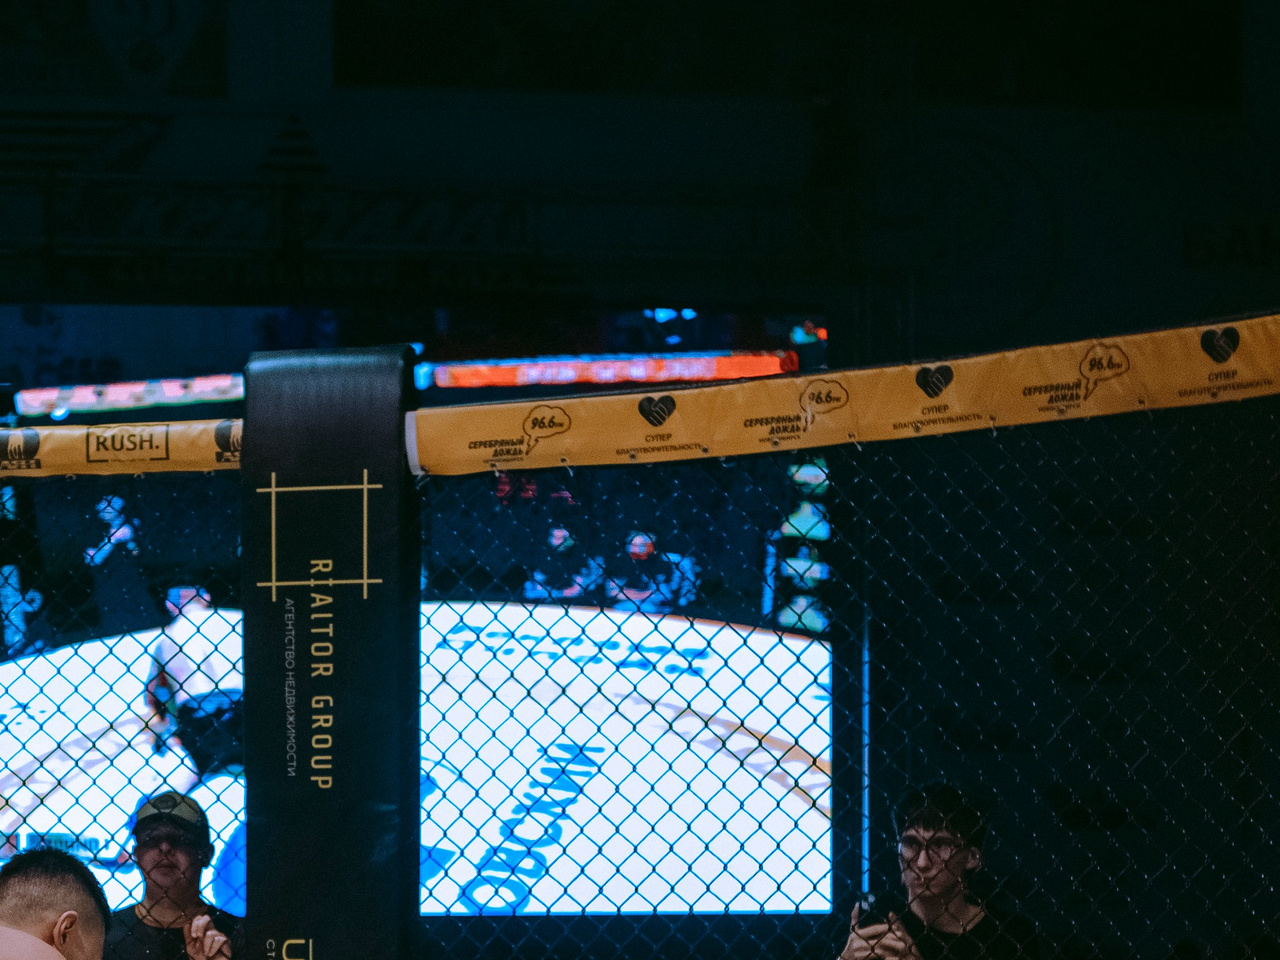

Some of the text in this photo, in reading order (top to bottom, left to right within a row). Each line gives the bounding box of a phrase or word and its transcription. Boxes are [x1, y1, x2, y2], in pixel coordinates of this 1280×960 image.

[1207, 369, 1238, 382] СУПЕР
[921, 404, 950, 416] СУПЕР
[644, 433, 672, 443] СУПЕР
[283, 597, 297, 777] АГЕНТСТВО НЕДВИЖИМОСТИ
[309, 694, 334, 790] GROUP
